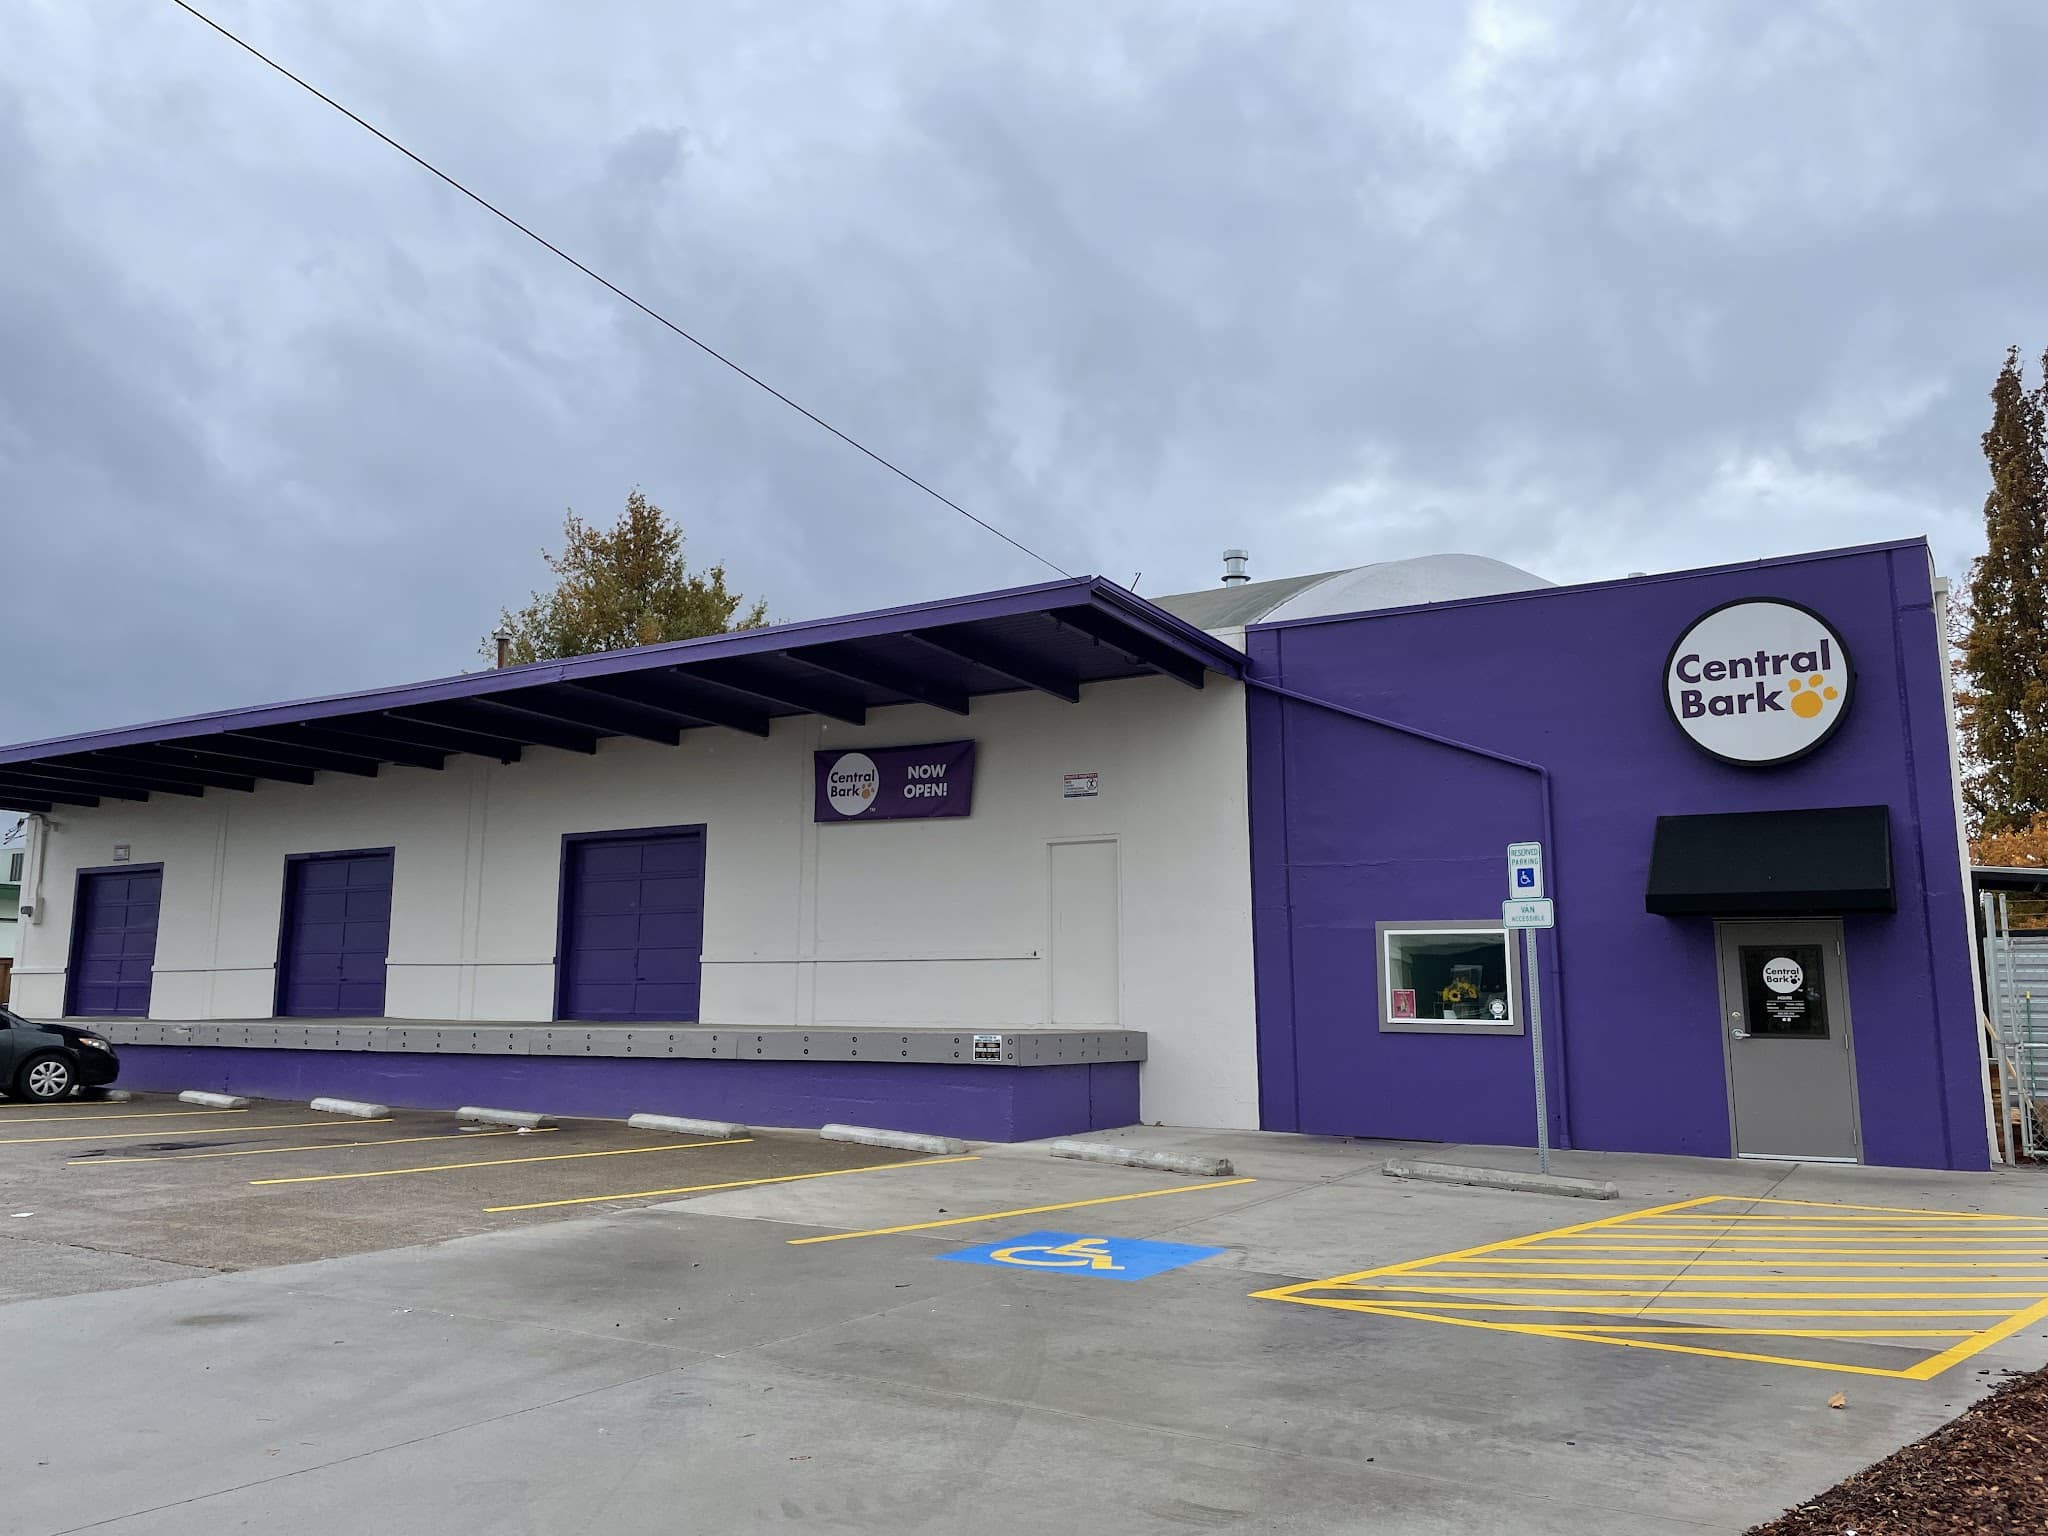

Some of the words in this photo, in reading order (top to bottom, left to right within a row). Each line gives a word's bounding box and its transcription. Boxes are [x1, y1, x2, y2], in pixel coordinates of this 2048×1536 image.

[1676, 638, 1831, 683] Central
[1680, 681, 1785, 719] Bark
[830, 769, 875, 784] Central
[907, 764, 947, 779] NOW
[830, 784, 860, 798] Bark
[903, 782, 948, 799] OPEN!
[1511, 848, 1538, 856] RESERVED
[1521, 905, 1535, 913] VAN
[1766, 967, 1799, 975] Central
[1766, 975, 1790, 983] Bark
